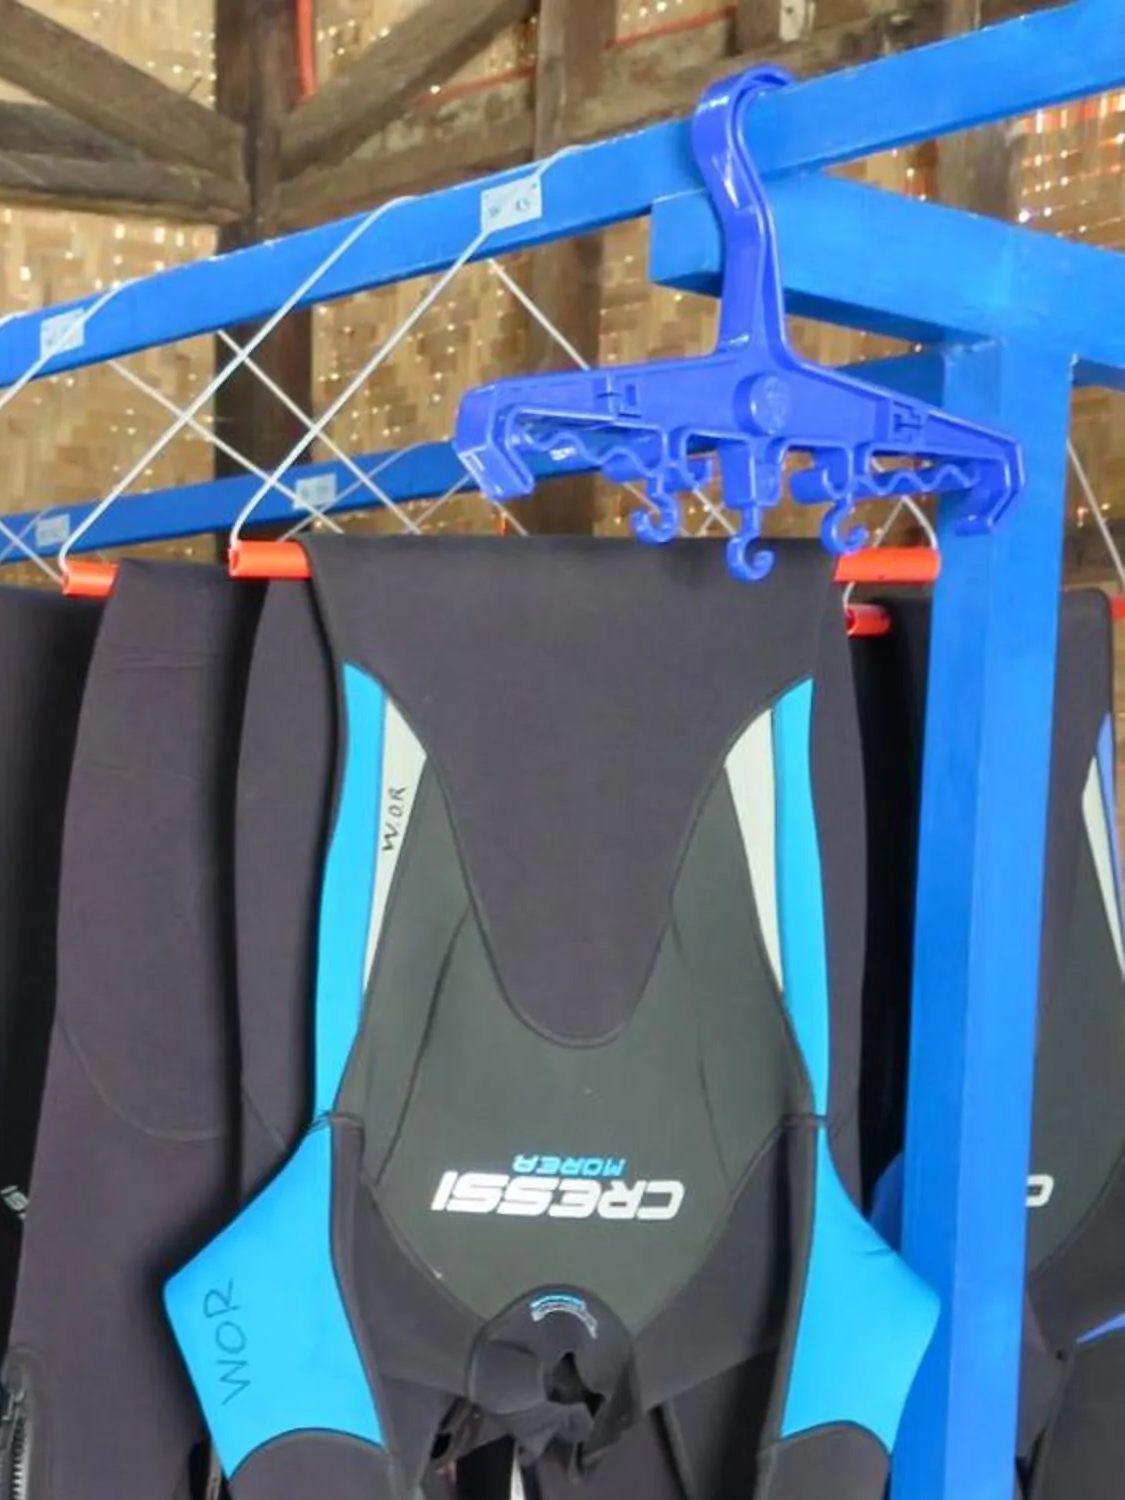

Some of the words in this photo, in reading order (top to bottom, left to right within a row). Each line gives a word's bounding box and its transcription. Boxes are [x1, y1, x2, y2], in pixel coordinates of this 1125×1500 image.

[512, 1154, 626, 1177] MOREA
[430, 1170, 685, 1220] CRESSI
[202, 1278, 251, 1406] WOR
